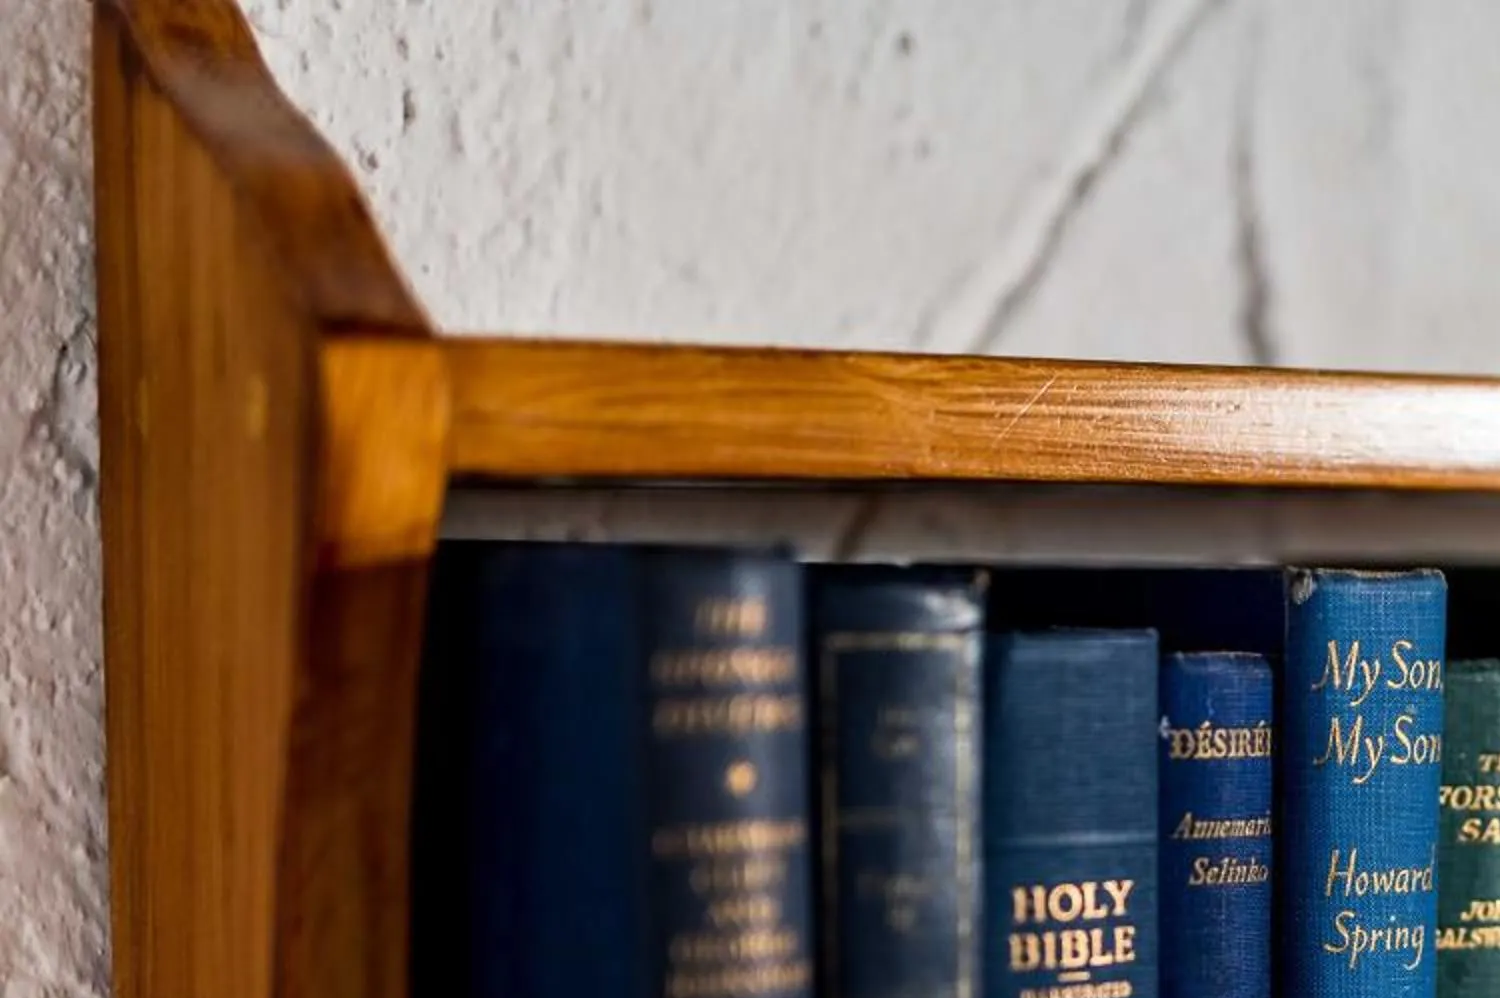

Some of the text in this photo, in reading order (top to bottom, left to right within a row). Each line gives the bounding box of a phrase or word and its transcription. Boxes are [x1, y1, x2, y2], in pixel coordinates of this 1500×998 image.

[1311, 640, 1381, 706] My
[1313, 715, 1442, 783] My Son
[1173, 811, 1272, 840] Annemari
[1188, 856, 1268, 887] Selinko
[1325, 843, 1435, 897] Howard
[1011, 879, 1135, 923] HOLY
[1008, 925, 1136, 971] BIBLE
[1324, 911, 1425, 970] Spring
